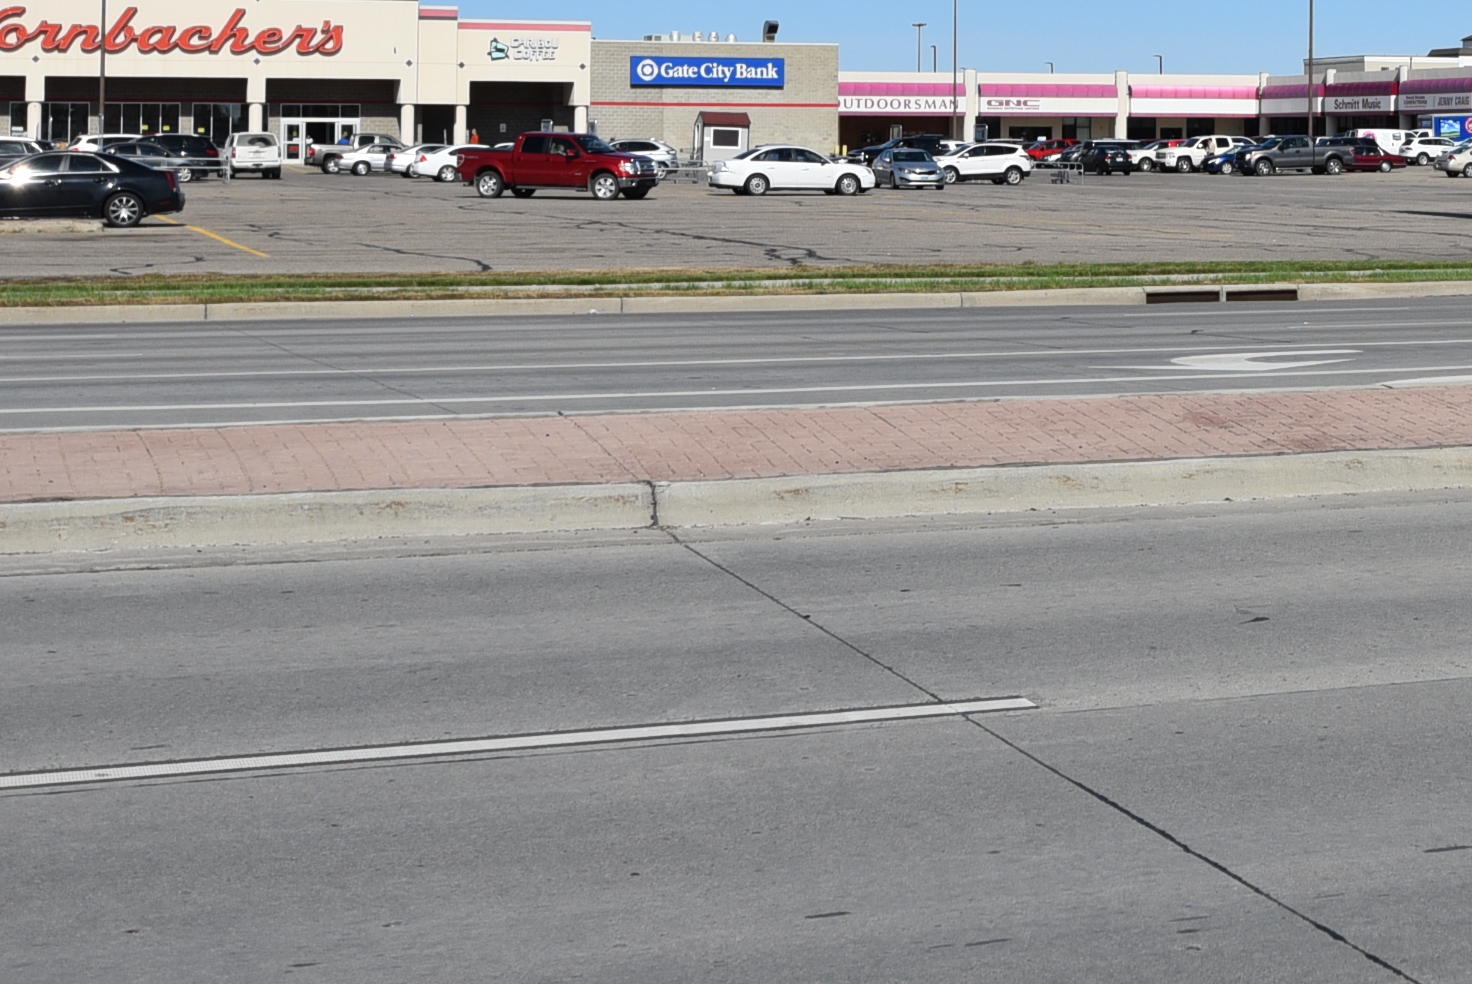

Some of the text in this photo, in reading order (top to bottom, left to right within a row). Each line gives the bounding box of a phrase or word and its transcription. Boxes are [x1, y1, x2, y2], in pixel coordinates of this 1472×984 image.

[660, 62, 779, 82] Gate City Bank
[986, 99, 1040, 107] GNC
[1334, 97, 1381, 110] Schmitt Music
